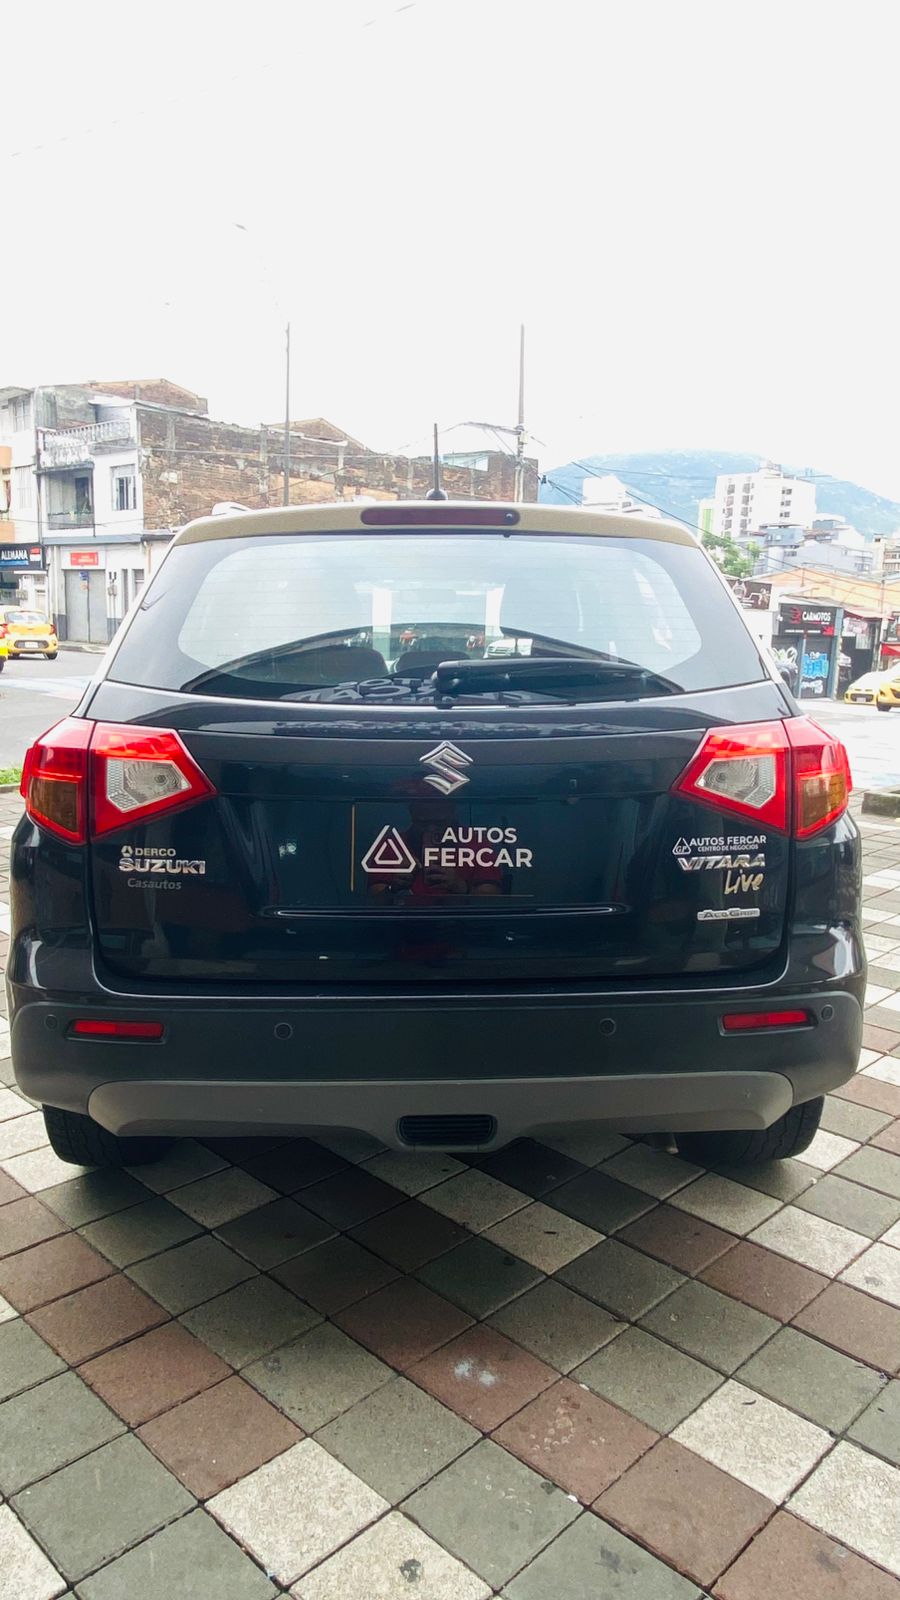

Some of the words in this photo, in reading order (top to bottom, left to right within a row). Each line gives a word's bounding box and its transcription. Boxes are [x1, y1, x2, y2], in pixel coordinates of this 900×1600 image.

[441, 827, 518, 843] AUTOS
[689, 837, 725, 846] AUTOS
[727, 835, 767, 844] FERCAR
[135, 848, 176, 857] DERCO
[424, 847, 533, 867] FERCAR
[119, 858, 206, 874] SUZUKI
[678, 853, 766, 871] VITARA
[127, 878, 182, 890] Casautos
[724, 869, 764, 895] Live
